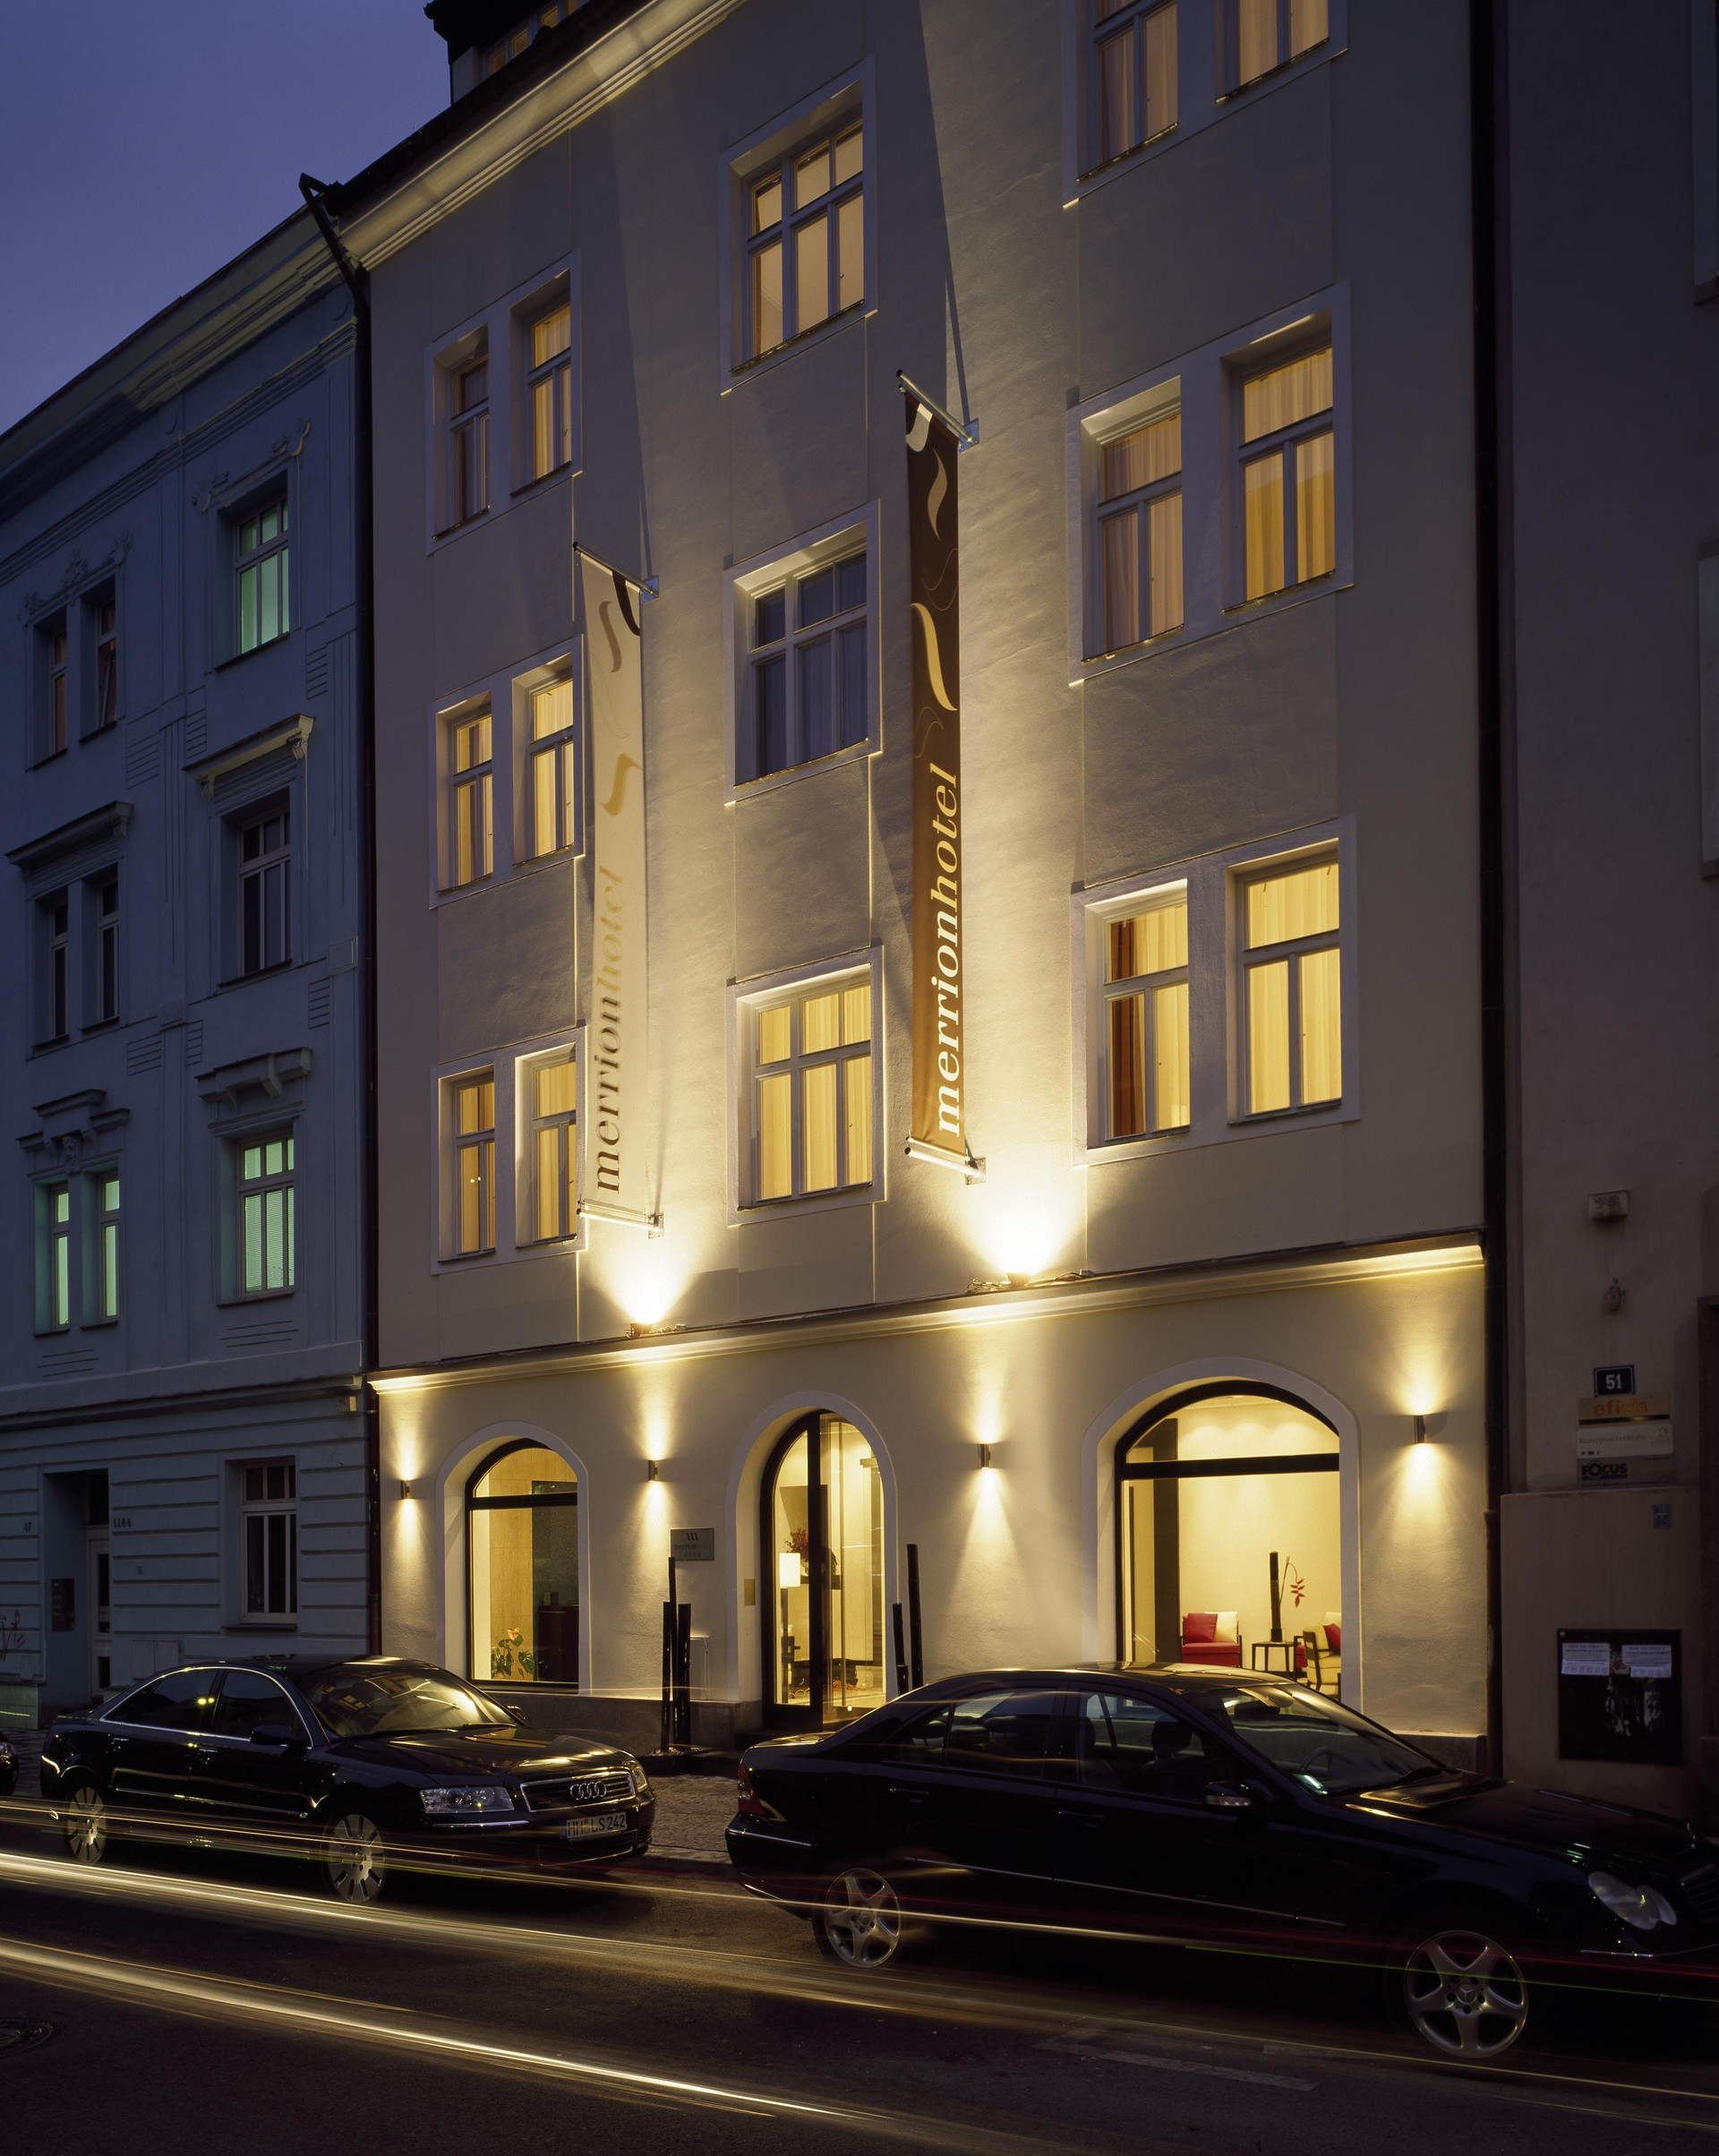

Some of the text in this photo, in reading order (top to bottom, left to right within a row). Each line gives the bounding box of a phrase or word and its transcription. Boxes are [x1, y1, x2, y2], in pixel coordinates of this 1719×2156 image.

[929, 763, 960, 1138] merrionhotel
[594, 865, 624, 1195] merrionhotel
[1605, 1373, 1622, 1390] 51
[1582, 1463, 1628, 1477] FOCUS
[607, 1814, 626, 1830] 242
